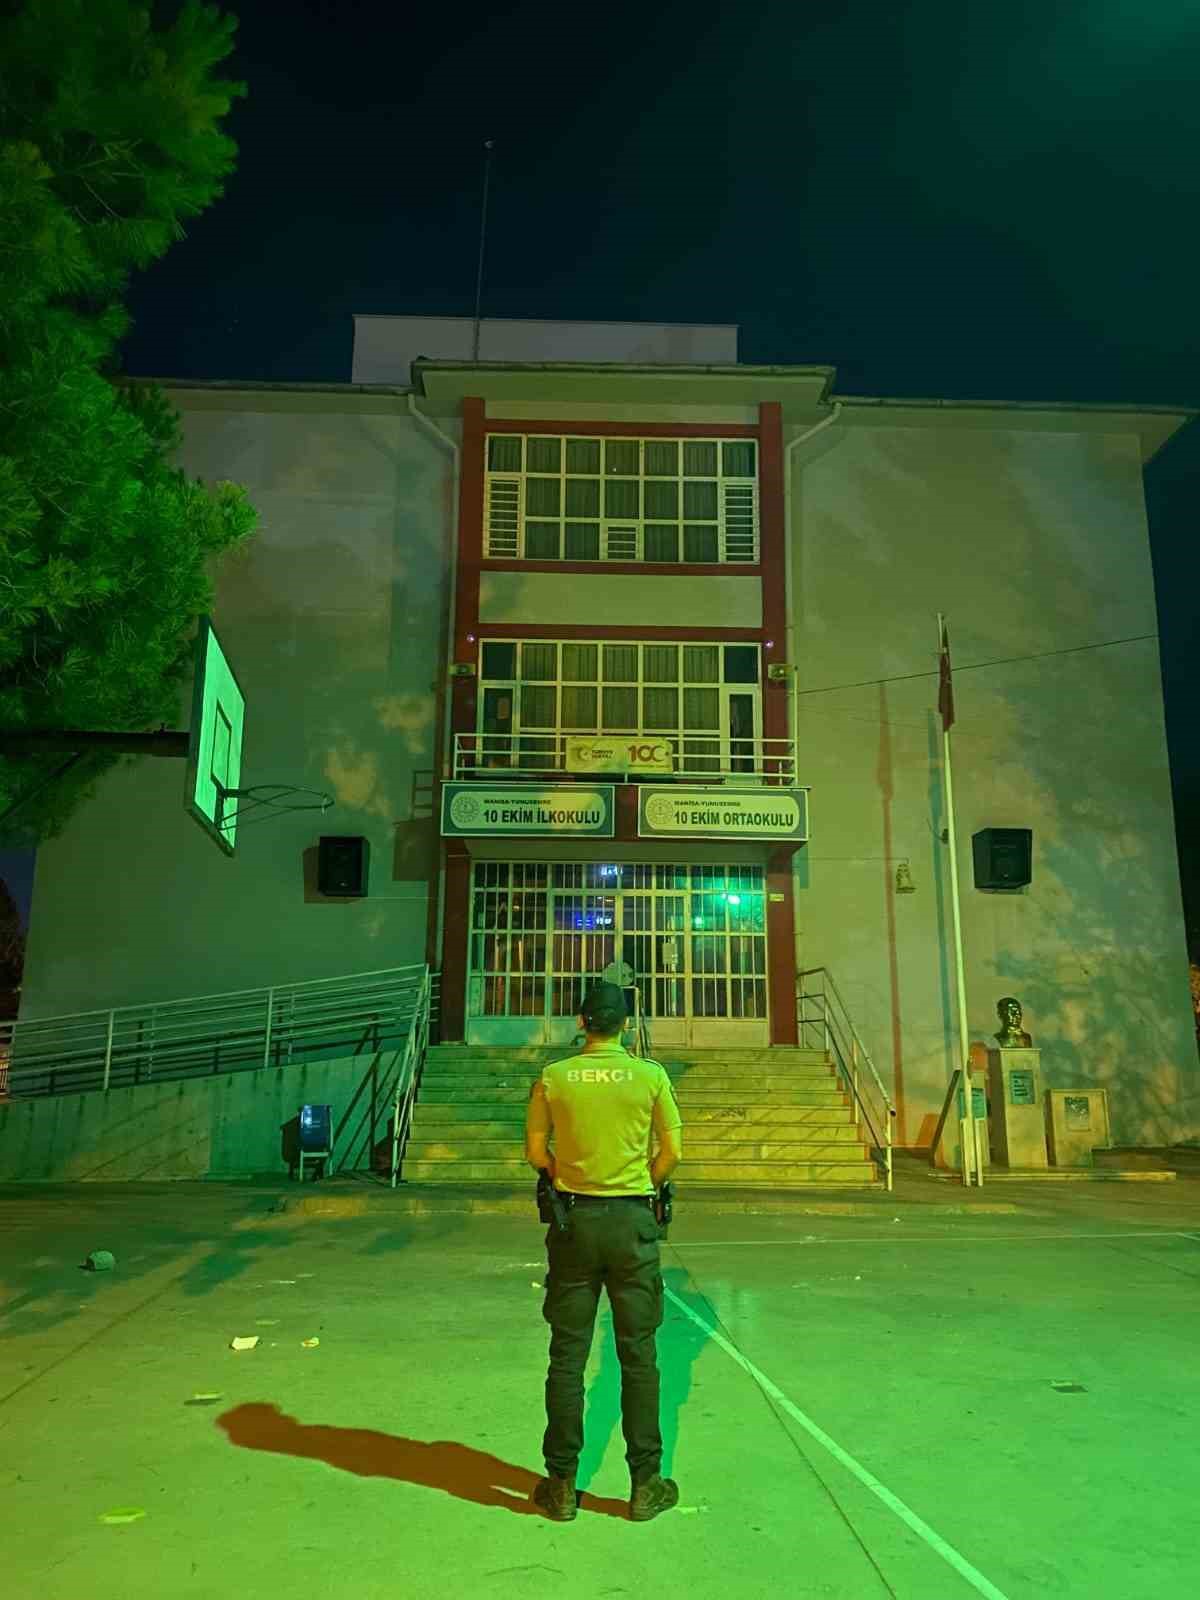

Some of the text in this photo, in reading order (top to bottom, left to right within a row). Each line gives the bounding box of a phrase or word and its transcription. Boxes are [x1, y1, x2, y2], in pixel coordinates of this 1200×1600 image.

[484, 809, 498, 823] 10
[501, 807, 533, 823] EKİM
[537, 807, 600, 824] İLKOKULU
[674, 810, 688, 825] 10
[691, 808, 720, 825] EKİM
[723, 811, 794, 826] ORTAOKULU
